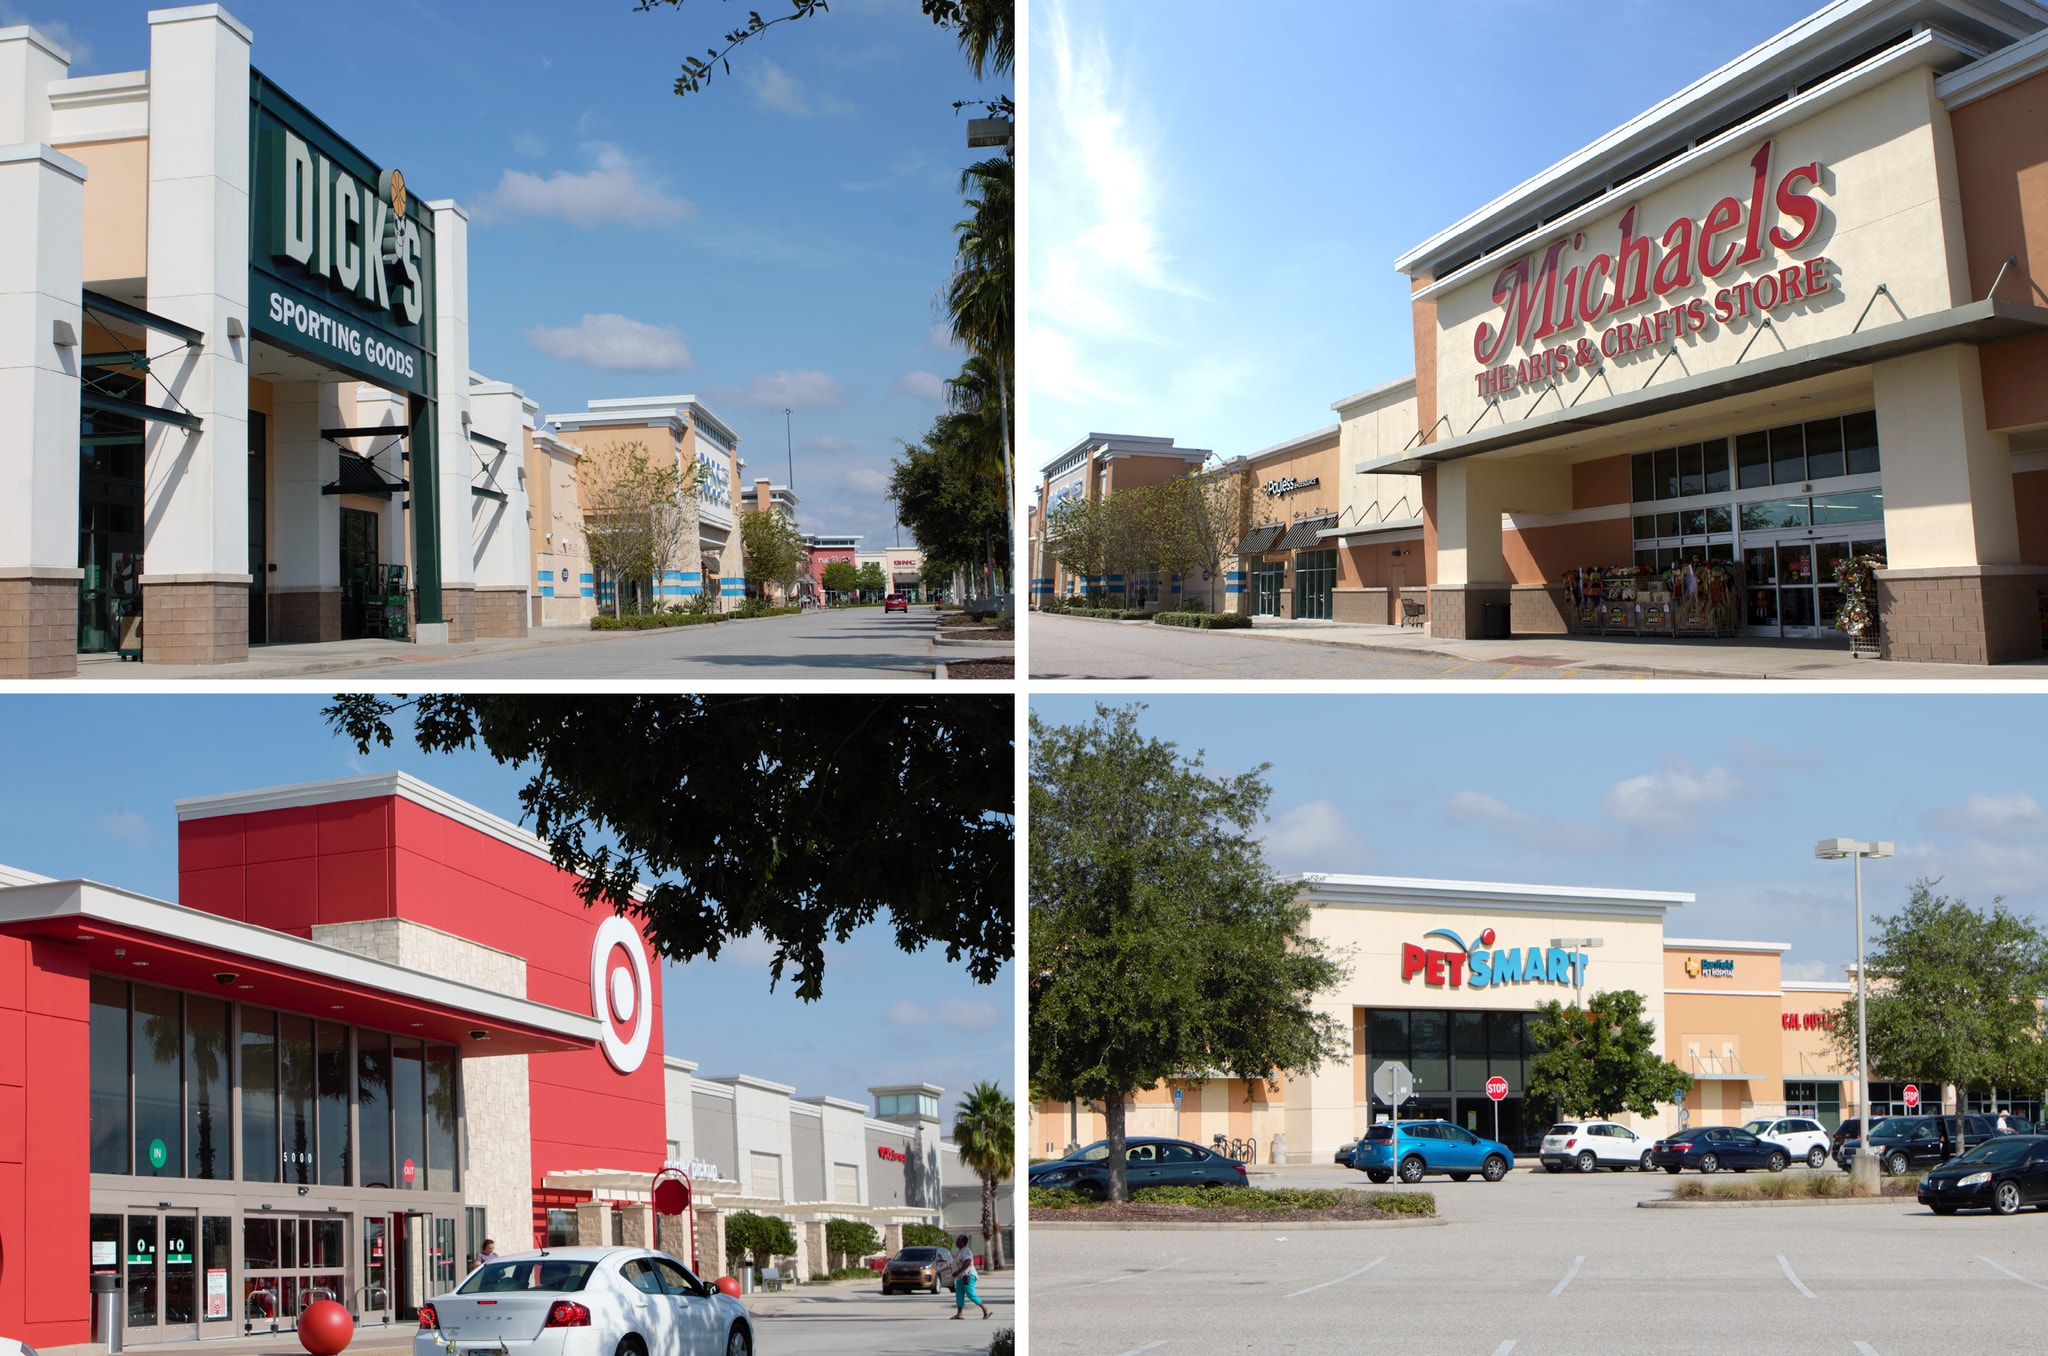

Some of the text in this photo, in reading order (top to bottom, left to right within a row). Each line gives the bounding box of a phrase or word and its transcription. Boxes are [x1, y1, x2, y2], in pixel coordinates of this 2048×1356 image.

[1474, 139, 1822, 364] Michaels
[1475, 257, 1830, 397] THE ARTS & CRAFTS STORE
[269, 292, 414, 379] SPORTING GOODS
[1267, 477, 1296, 497] Payless
[1402, 942, 1589, 988] PETSMART
[1701, 959, 1734, 970] Banfield
[1487, 1083, 1507, 1094] STOP
[1904, 1091, 1918, 1102] STOP
[153, 1147, 162, 1159] IN
[283, 1152, 312, 1163] 5000
[403, 1166, 415, 1176] OUT
[691, 1158, 718, 1180] pickup
